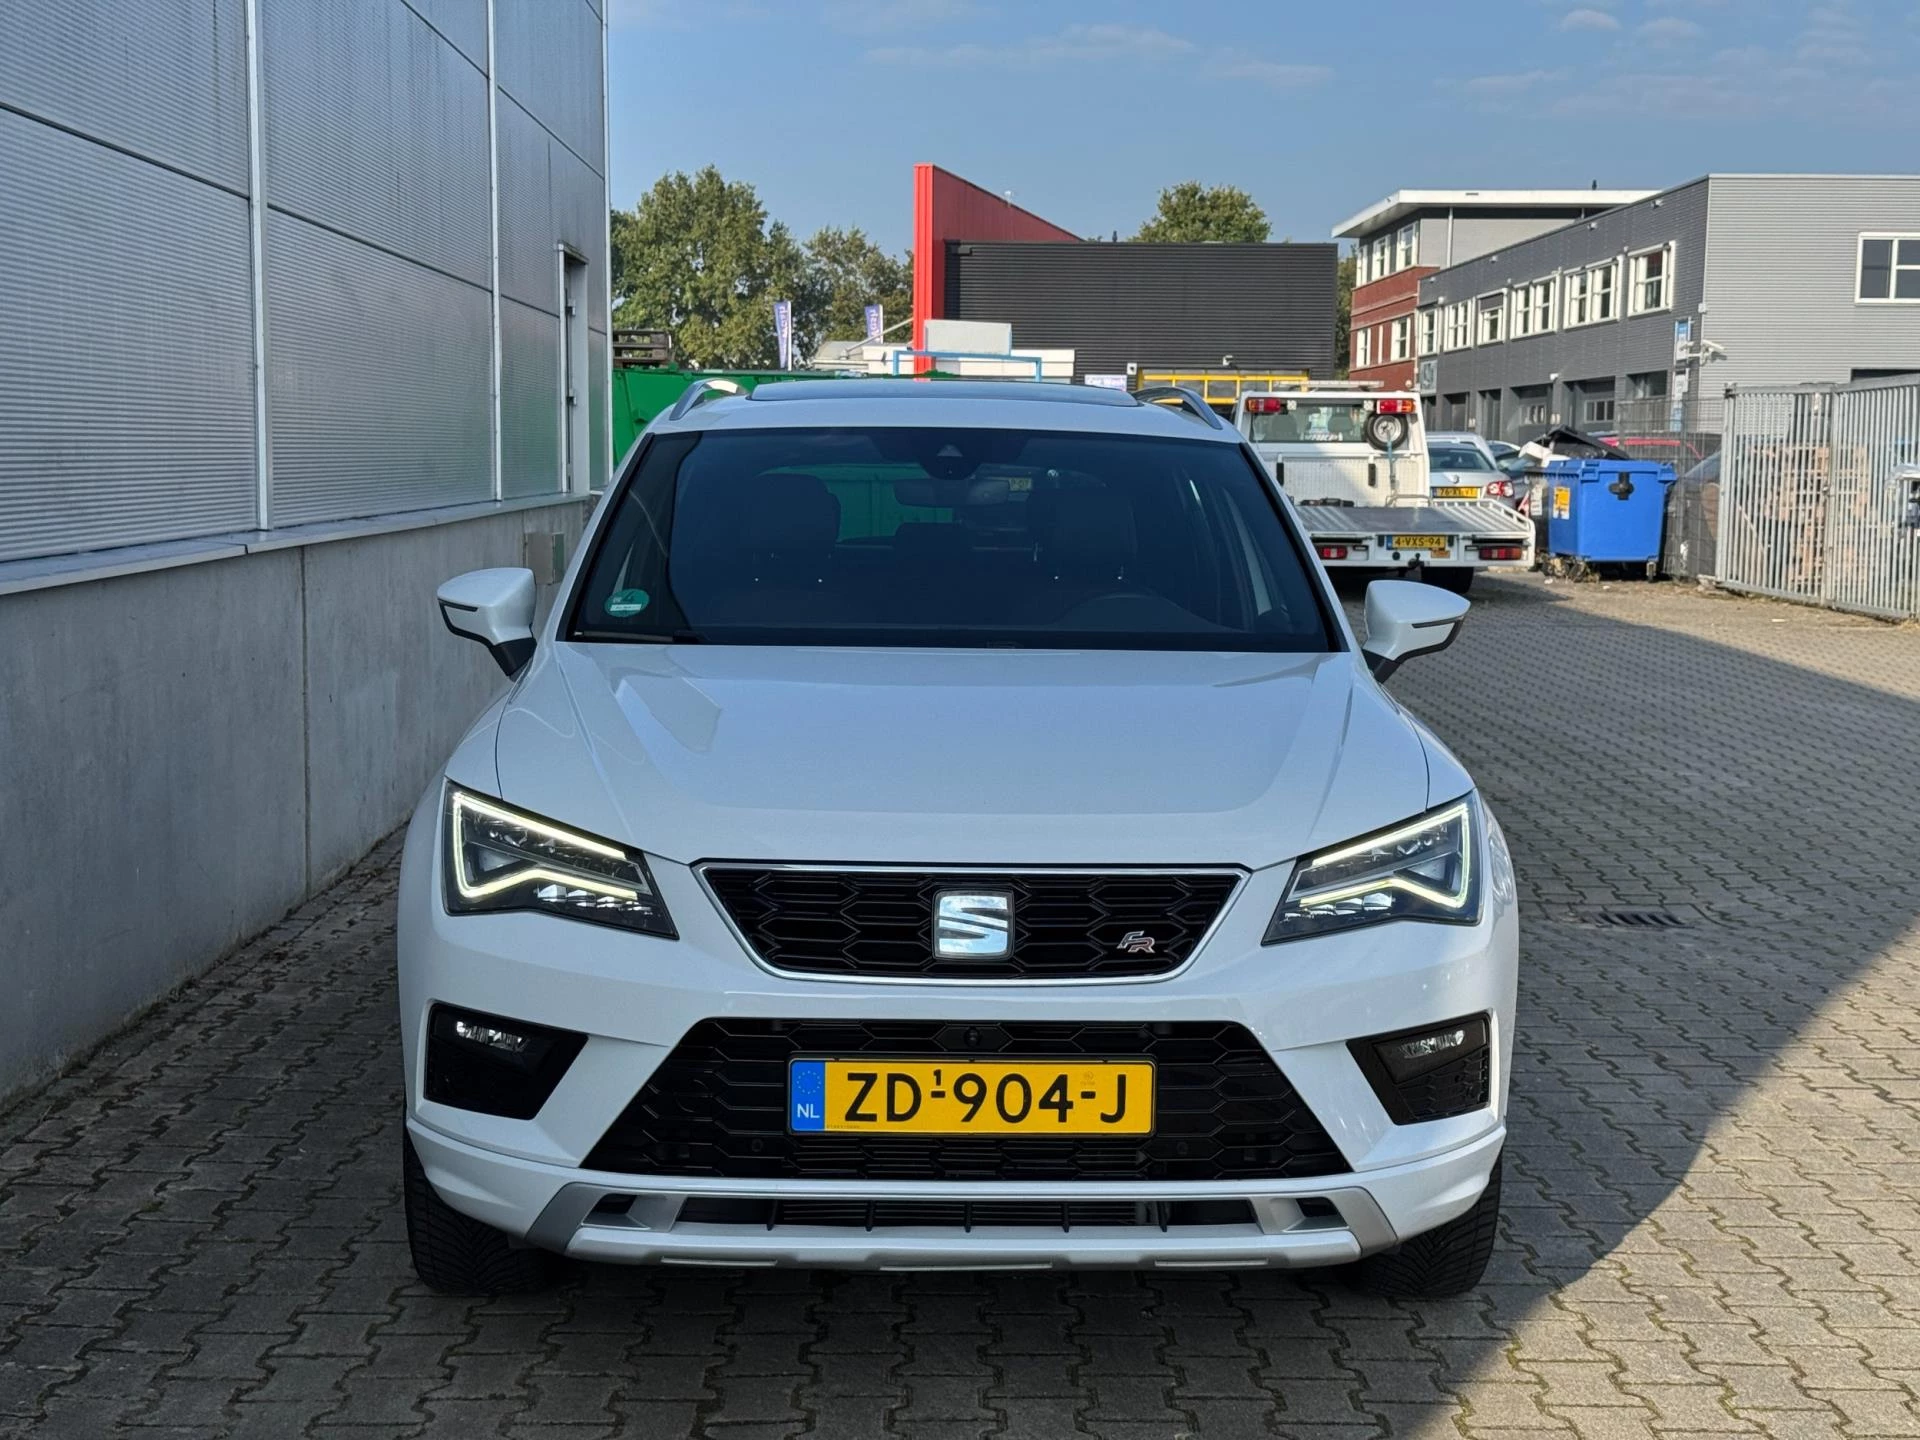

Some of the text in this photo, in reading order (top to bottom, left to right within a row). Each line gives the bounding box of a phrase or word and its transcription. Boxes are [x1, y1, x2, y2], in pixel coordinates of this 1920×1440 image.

[1394, 537, 1441, 547] 4-VXS-94
[1116, 930, 1156, 953] FR
[797, 1103, 820, 1118] NL
